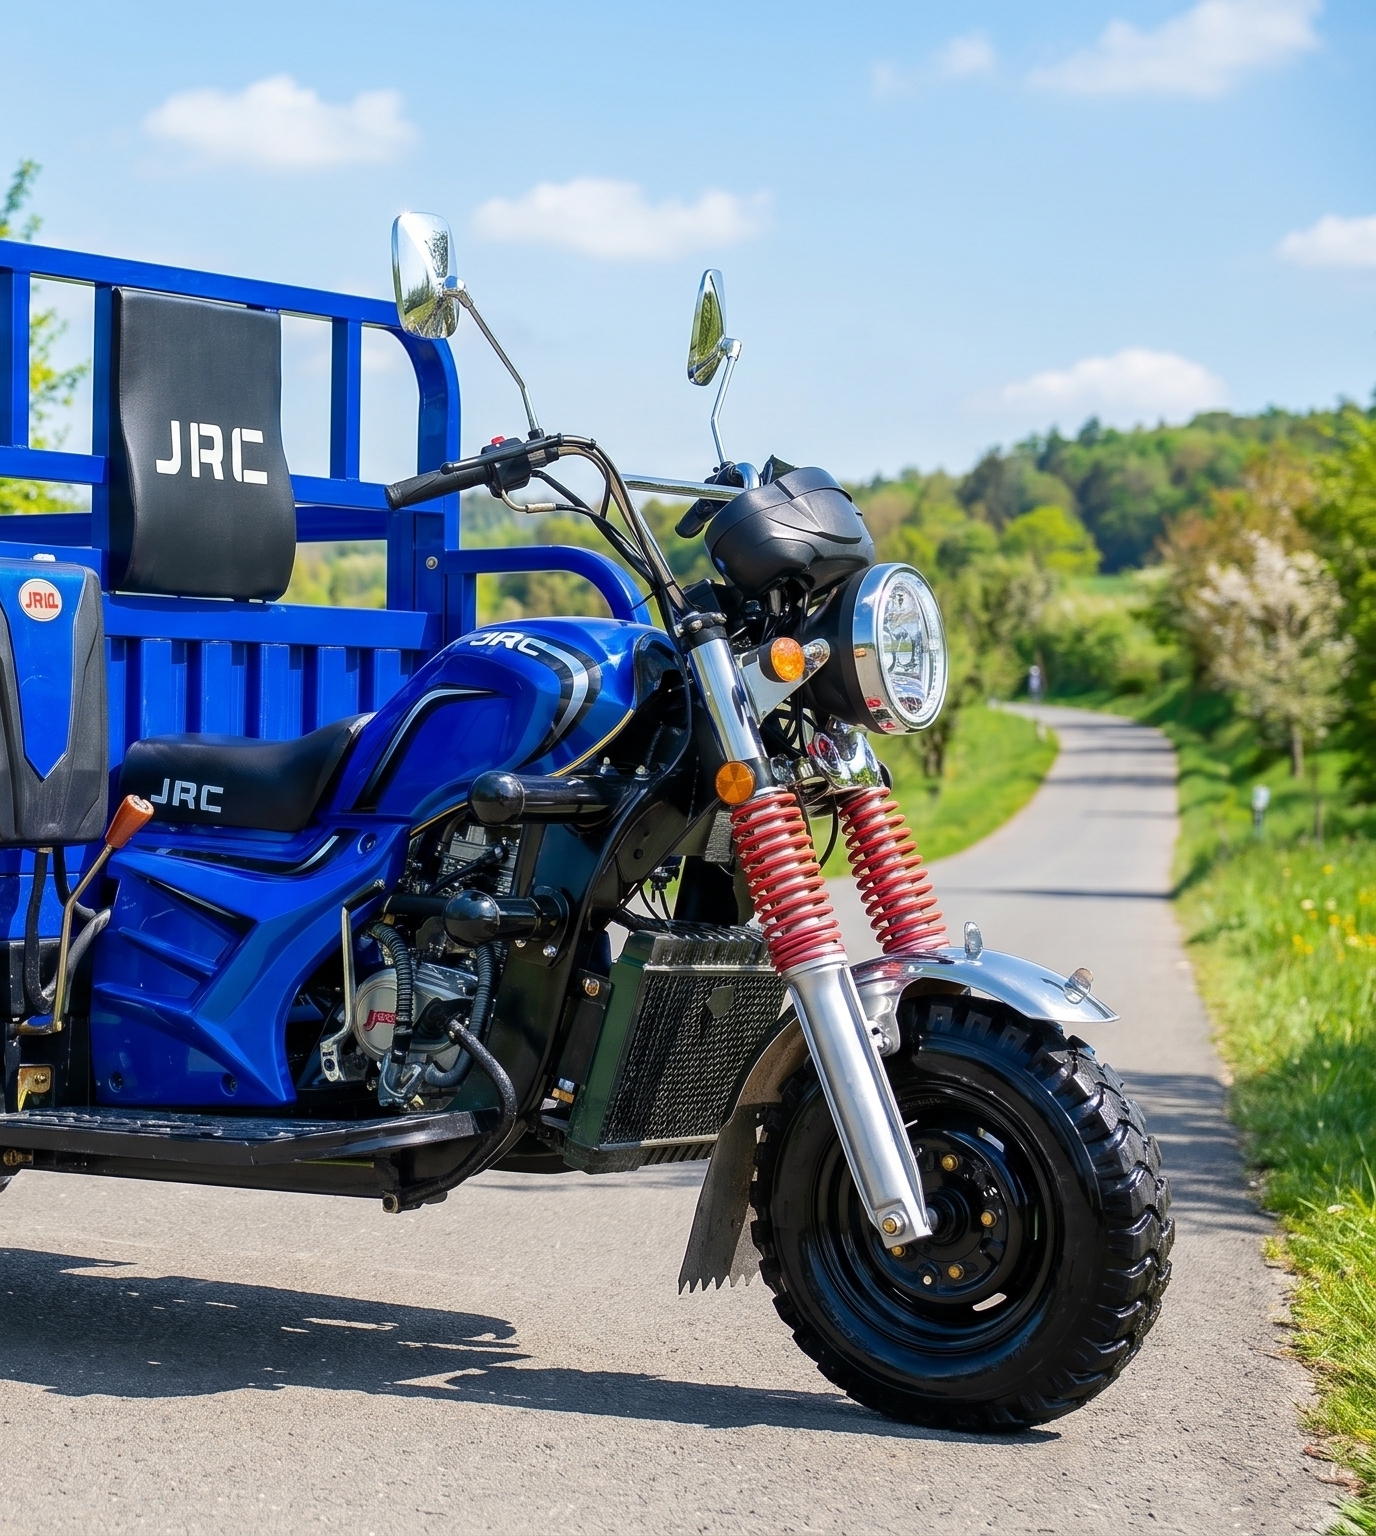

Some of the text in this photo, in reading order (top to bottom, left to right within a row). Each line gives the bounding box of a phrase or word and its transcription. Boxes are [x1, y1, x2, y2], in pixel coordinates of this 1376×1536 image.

[155, 419, 269, 485] JRC
[469, 631, 544, 657] JRC
[150, 778, 224, 814] JRC
